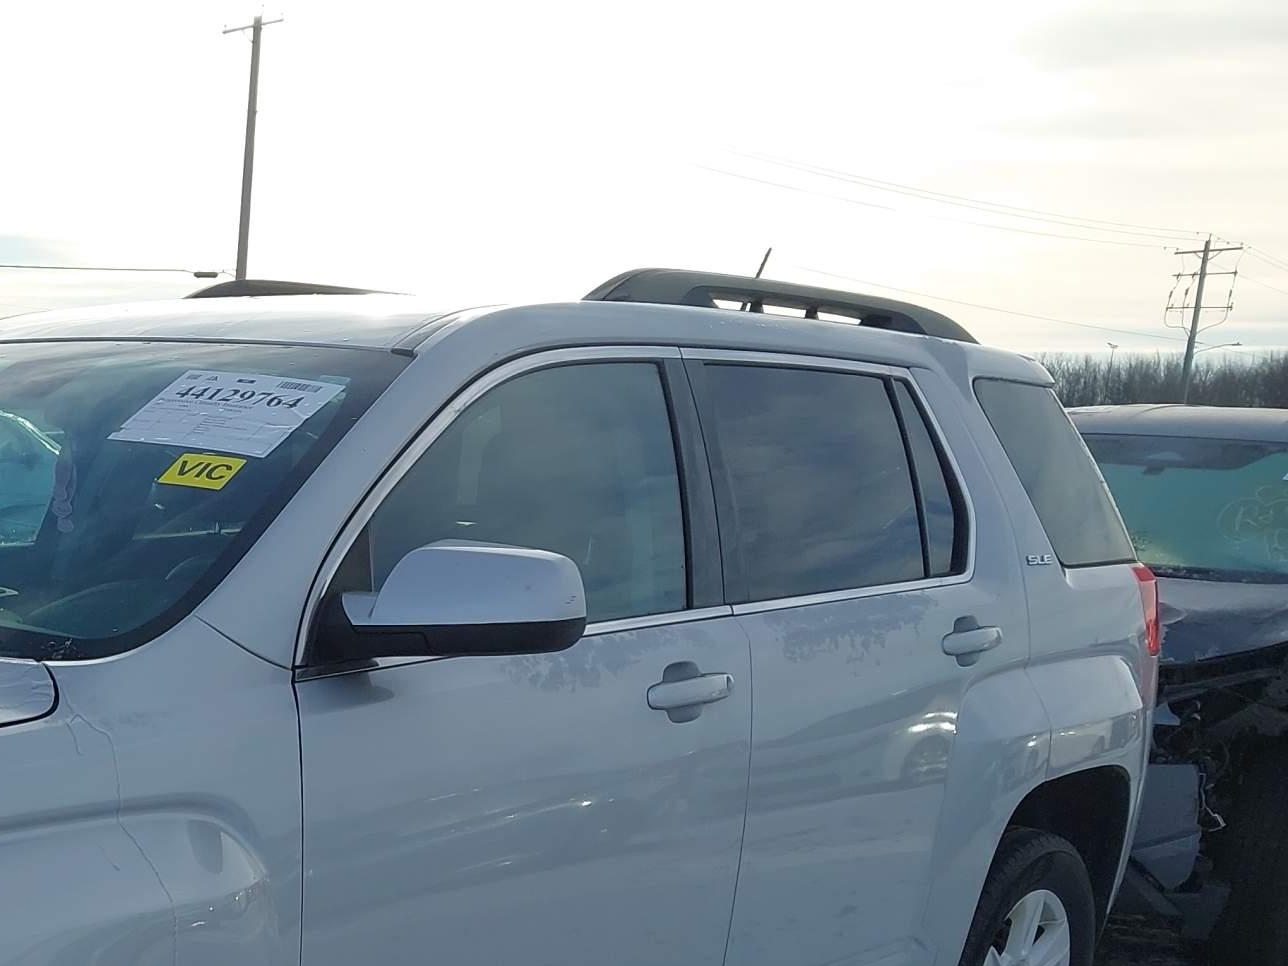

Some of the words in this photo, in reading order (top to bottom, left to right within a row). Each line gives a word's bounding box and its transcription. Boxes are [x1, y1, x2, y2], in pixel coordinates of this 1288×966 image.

[175, 385, 305, 409] 44129764
[177, 460, 233, 482] VIC
[1025, 554, 1053, 567] SLE
